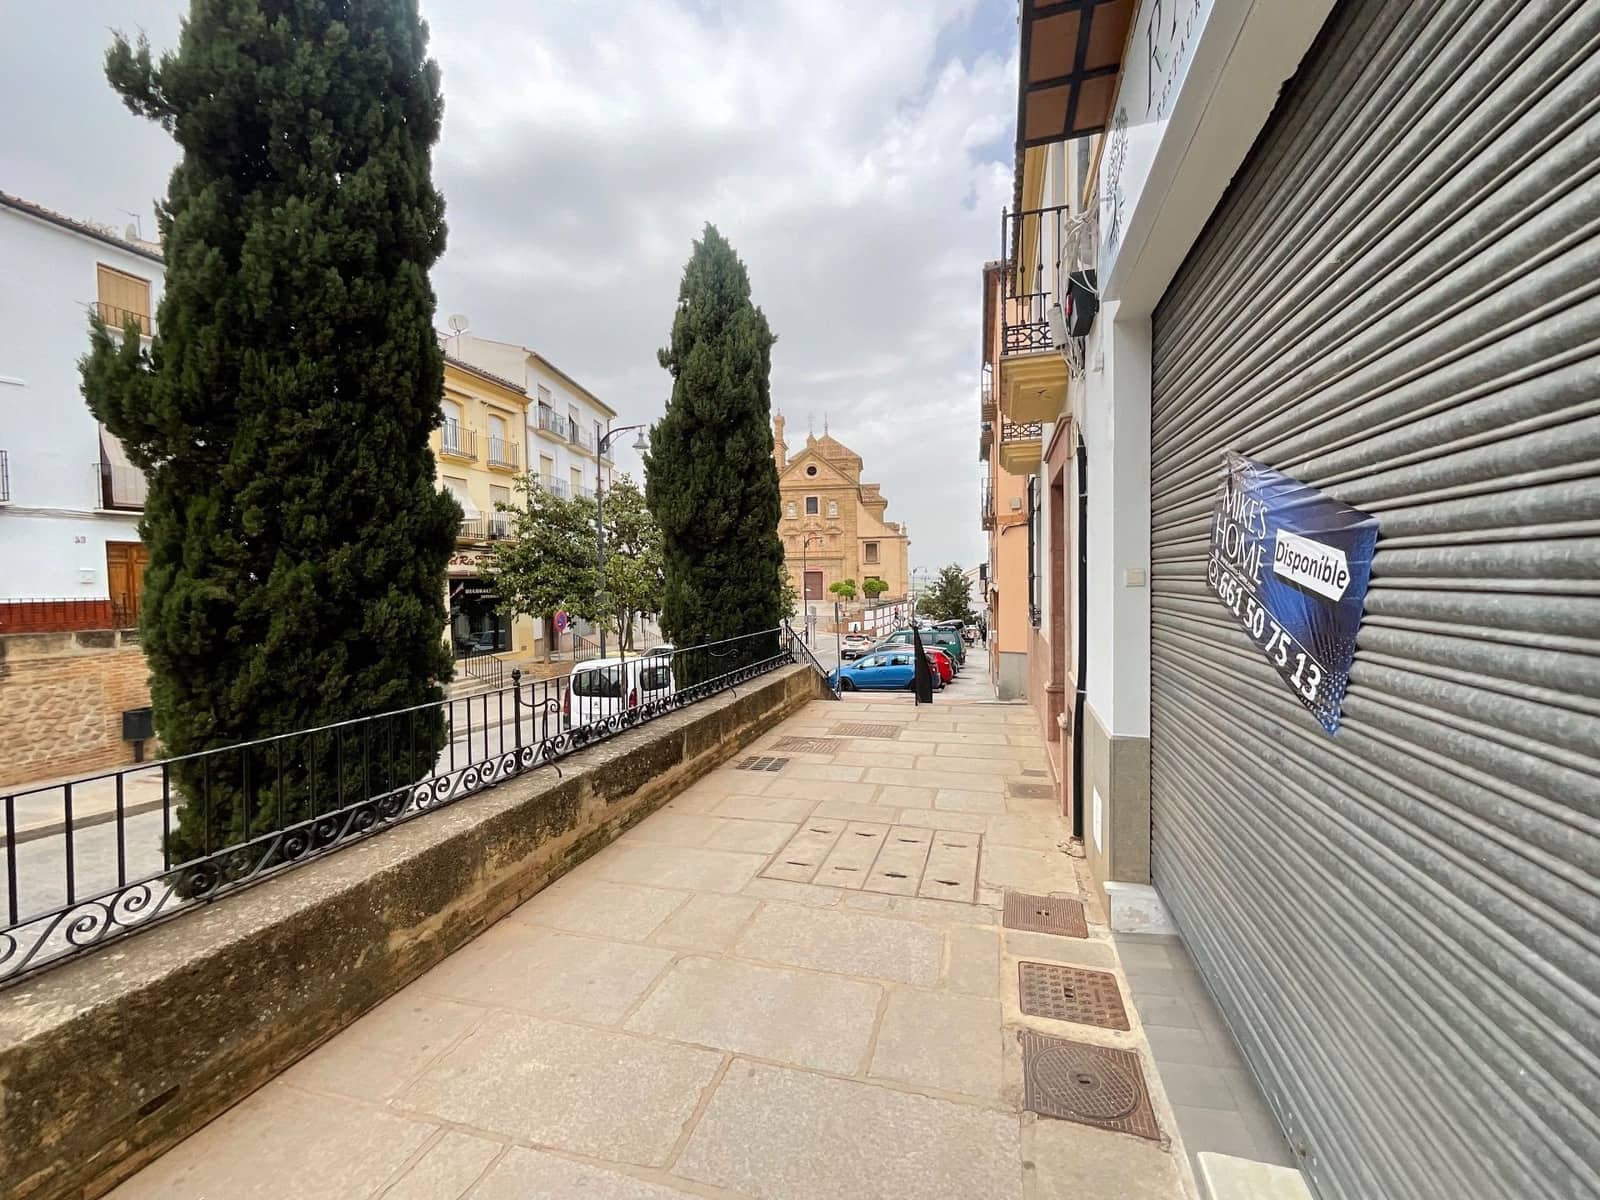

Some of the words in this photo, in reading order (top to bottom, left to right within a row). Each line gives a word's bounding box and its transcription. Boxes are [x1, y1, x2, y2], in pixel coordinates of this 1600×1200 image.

[1222, 485, 1268, 540] MIKE'S
[1215, 512, 1267, 585] HOME
[1275, 540, 1347, 590] Disponible
[1218, 571, 1244, 617] 661
[1242, 597, 1265, 639] 50
[1264, 620, 1292, 667] 75
[1290, 652, 1322, 701] 13
